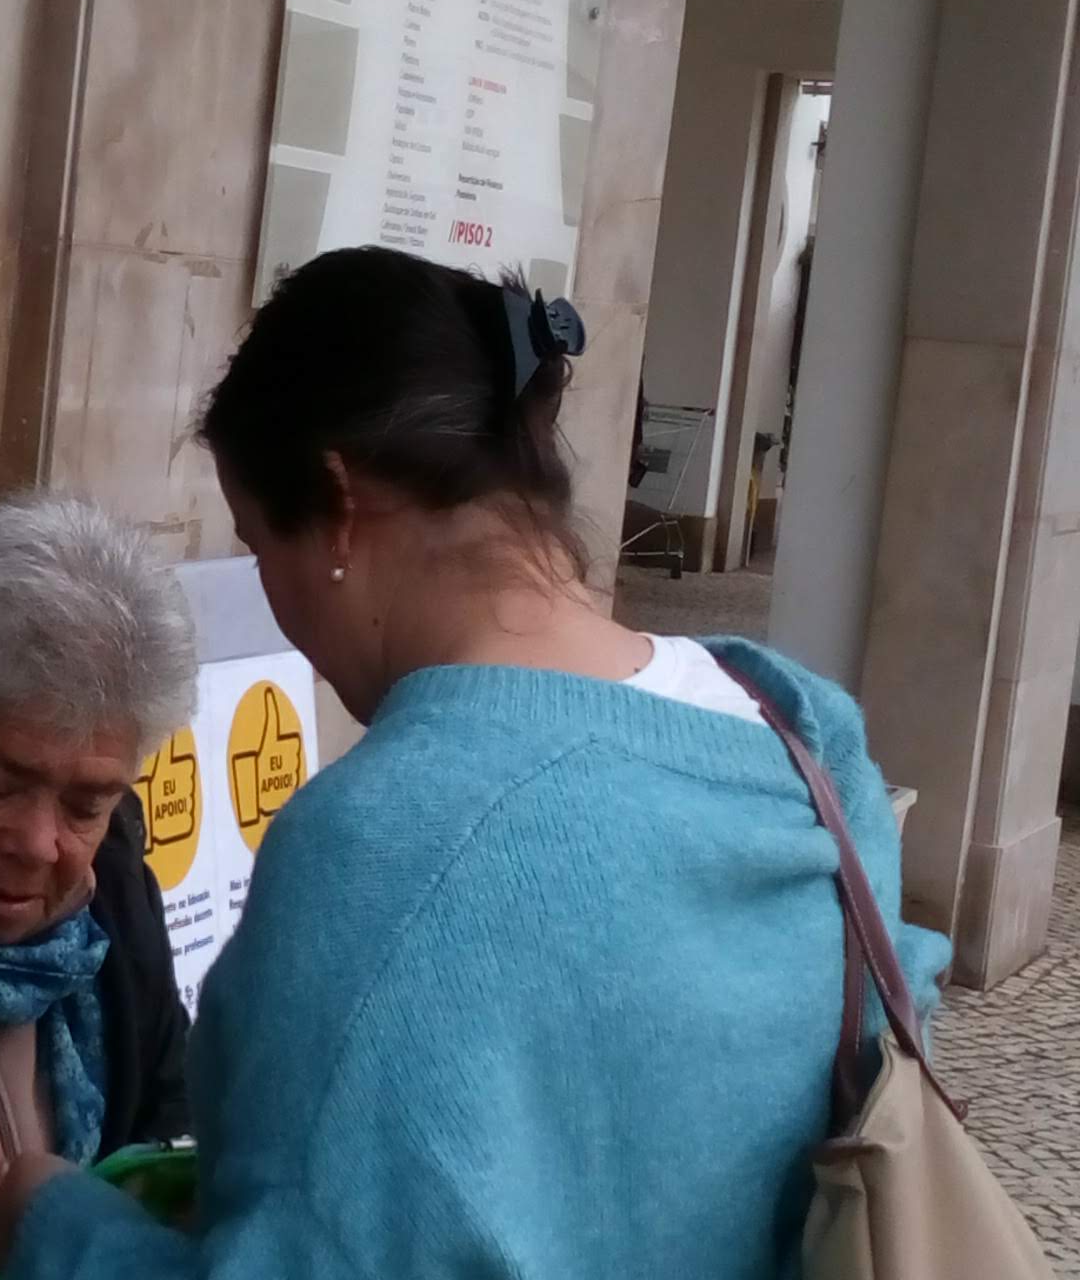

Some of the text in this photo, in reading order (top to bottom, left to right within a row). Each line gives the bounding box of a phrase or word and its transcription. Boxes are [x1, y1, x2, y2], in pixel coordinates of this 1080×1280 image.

[484, 226, 494, 248] 2
[269, 755, 283, 772] EU
[163, 779, 176, 797] EU
[261, 772, 294, 794] APOIO!
[154, 798, 188, 822] APOIO!
